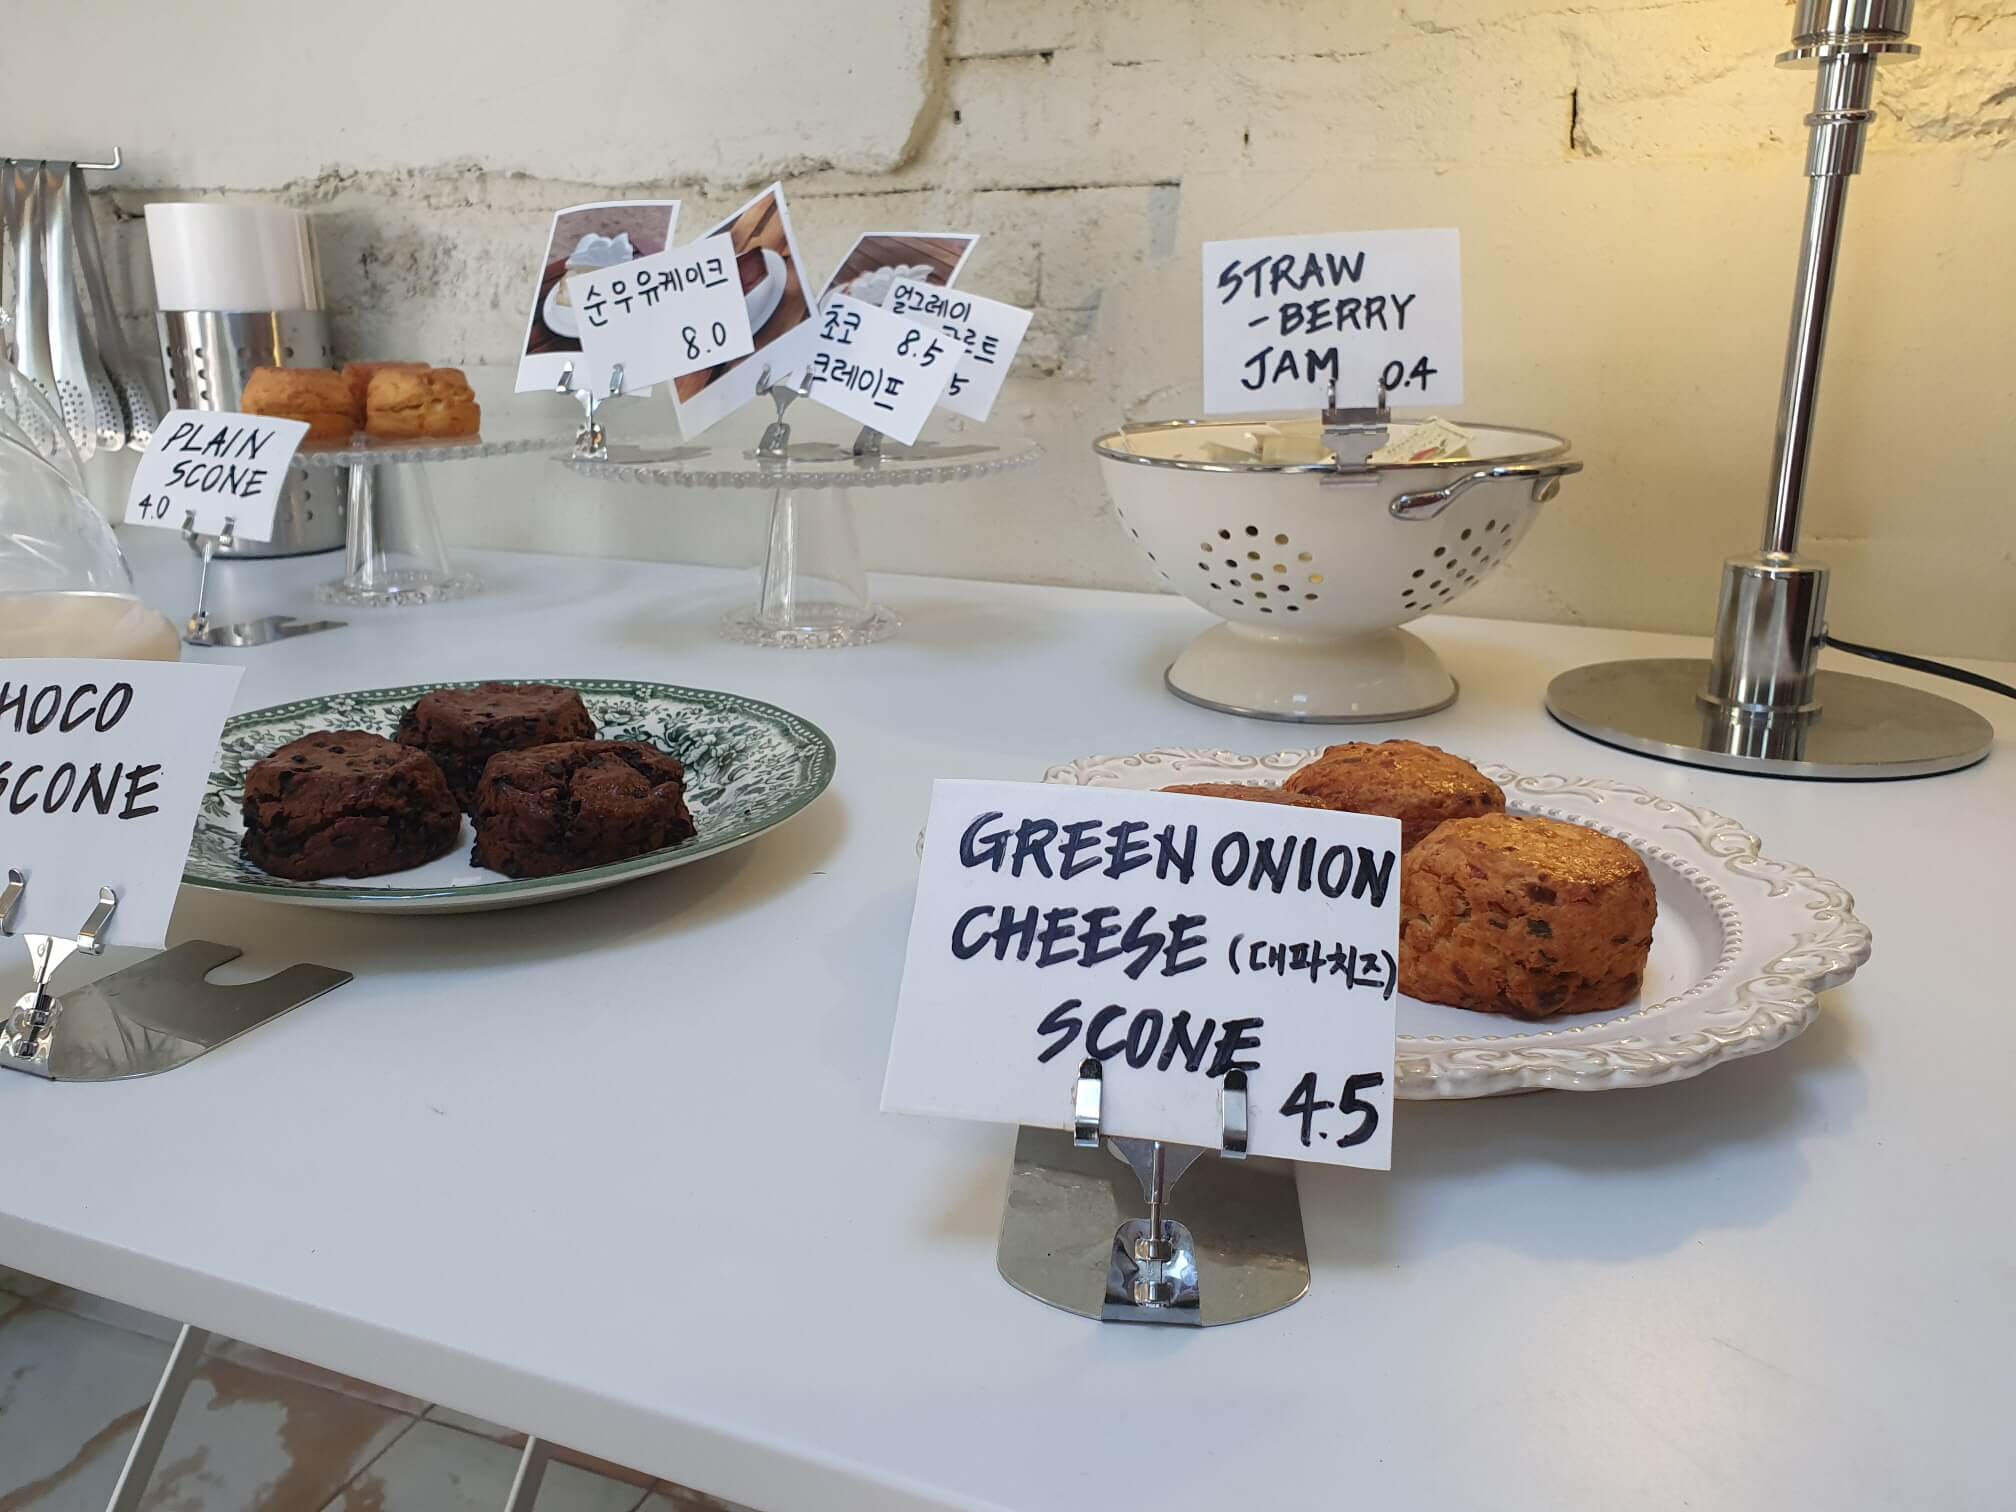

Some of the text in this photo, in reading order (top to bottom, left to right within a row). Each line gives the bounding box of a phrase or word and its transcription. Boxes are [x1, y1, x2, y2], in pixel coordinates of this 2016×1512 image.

[583, 257, 729, 328] 순우유케이크
[892, 284, 973, 323] 얼그레이
[1217, 251, 1366, 305] STRAW
[681, 321, 727, 361] 8.0
[819, 303, 945, 368] 초코 8.5
[811, 352, 905, 411] 크레이프
[1240, 346, 1439, 392] JAM 0.4
[160, 421, 276, 460] PLAIN
[164, 459, 268, 498] SCONE
[137, 493, 171, 521] 4.0
[958, 810, 1396, 908] GREEN ONION
[950, 905, 1398, 1001] CHEESE (대파치즈)
[1036, 998, 1265, 1079] SCONE
[1278, 1071, 1385, 1149] 4.5
